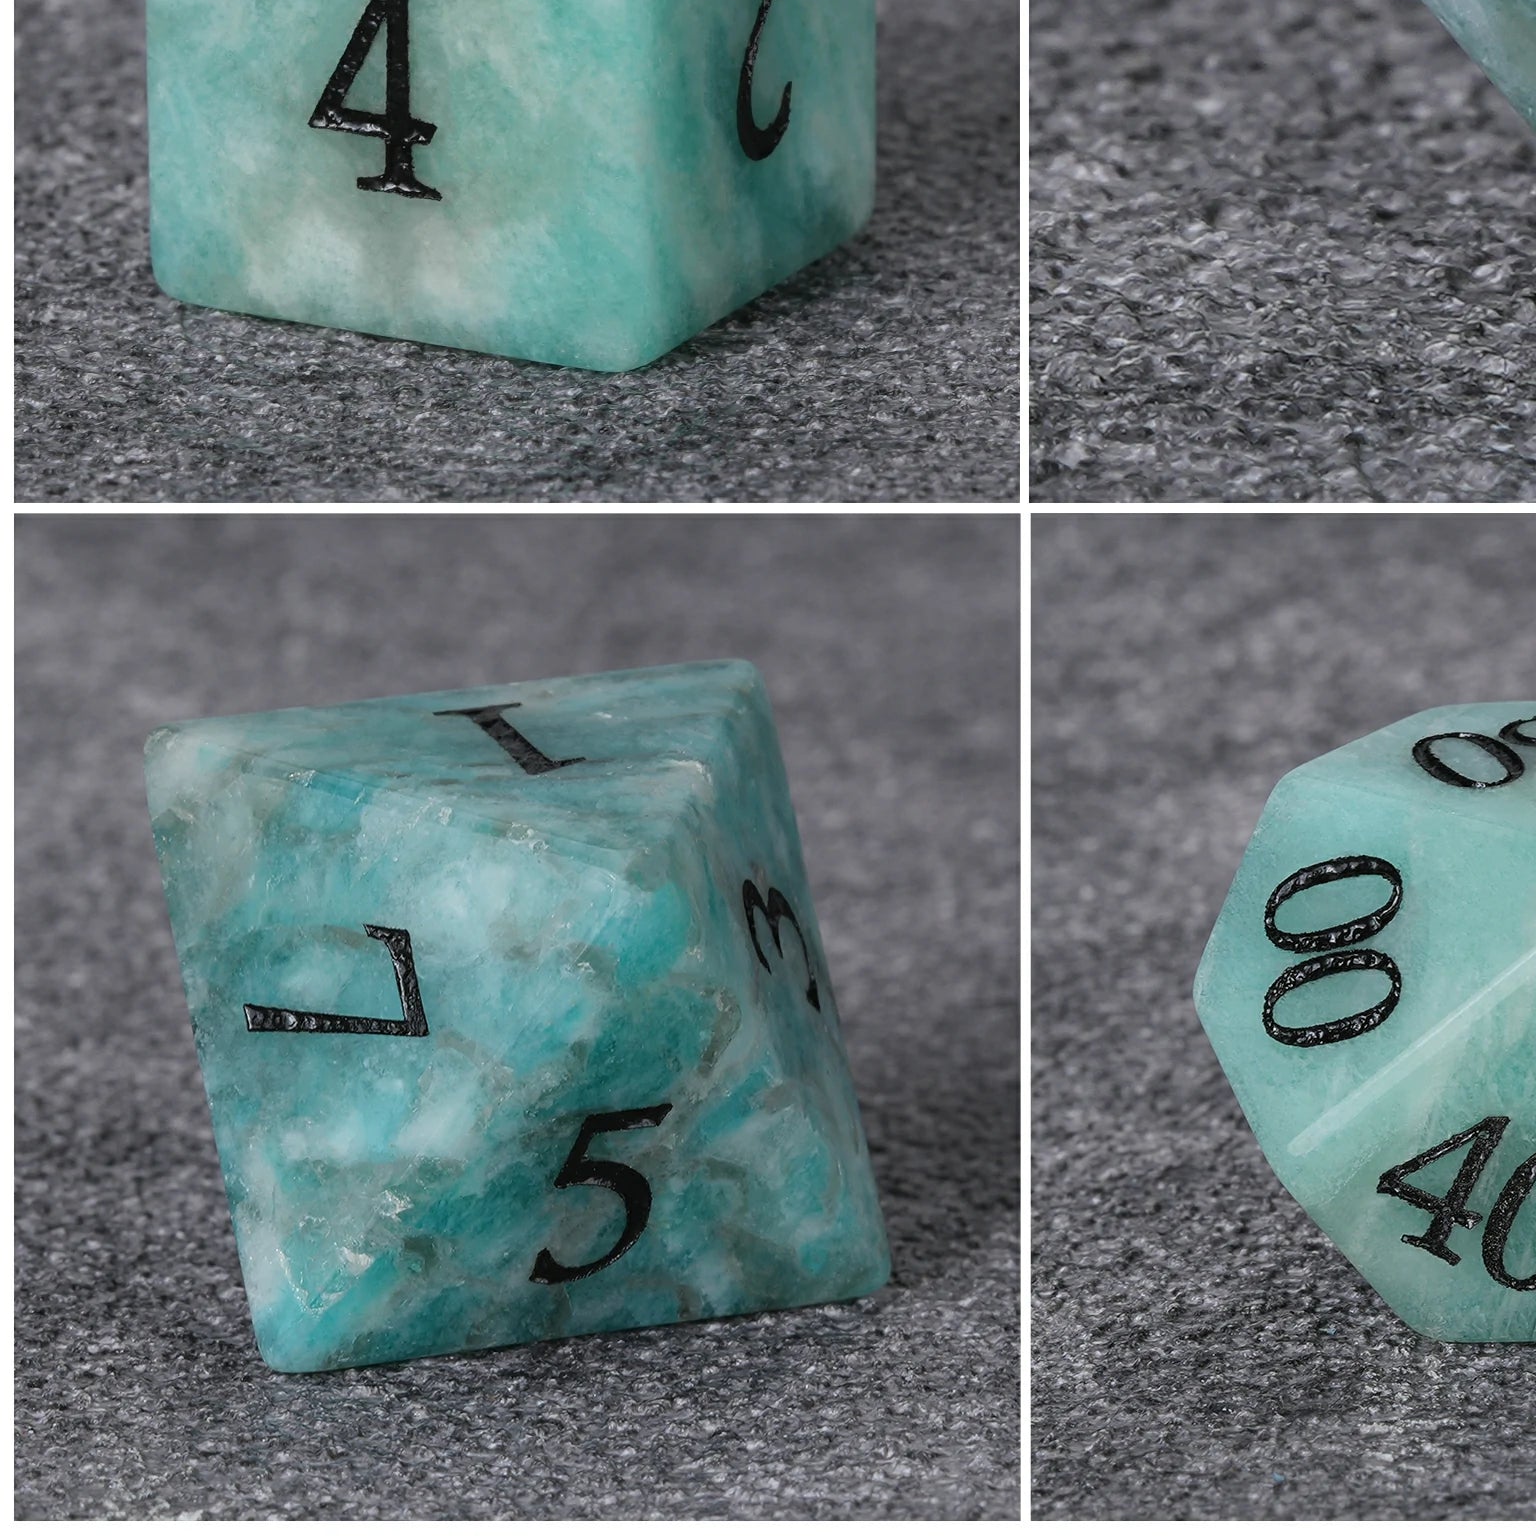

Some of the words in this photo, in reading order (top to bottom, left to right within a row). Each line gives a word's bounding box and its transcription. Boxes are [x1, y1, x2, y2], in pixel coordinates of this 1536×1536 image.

[434, 703, 586, 775] 1
[243, 925, 430, 1037] 7
[742, 879, 821, 1013] 3
[1262, 855, 1403, 1048] 00
[530, 1104, 673, 1286] 5
